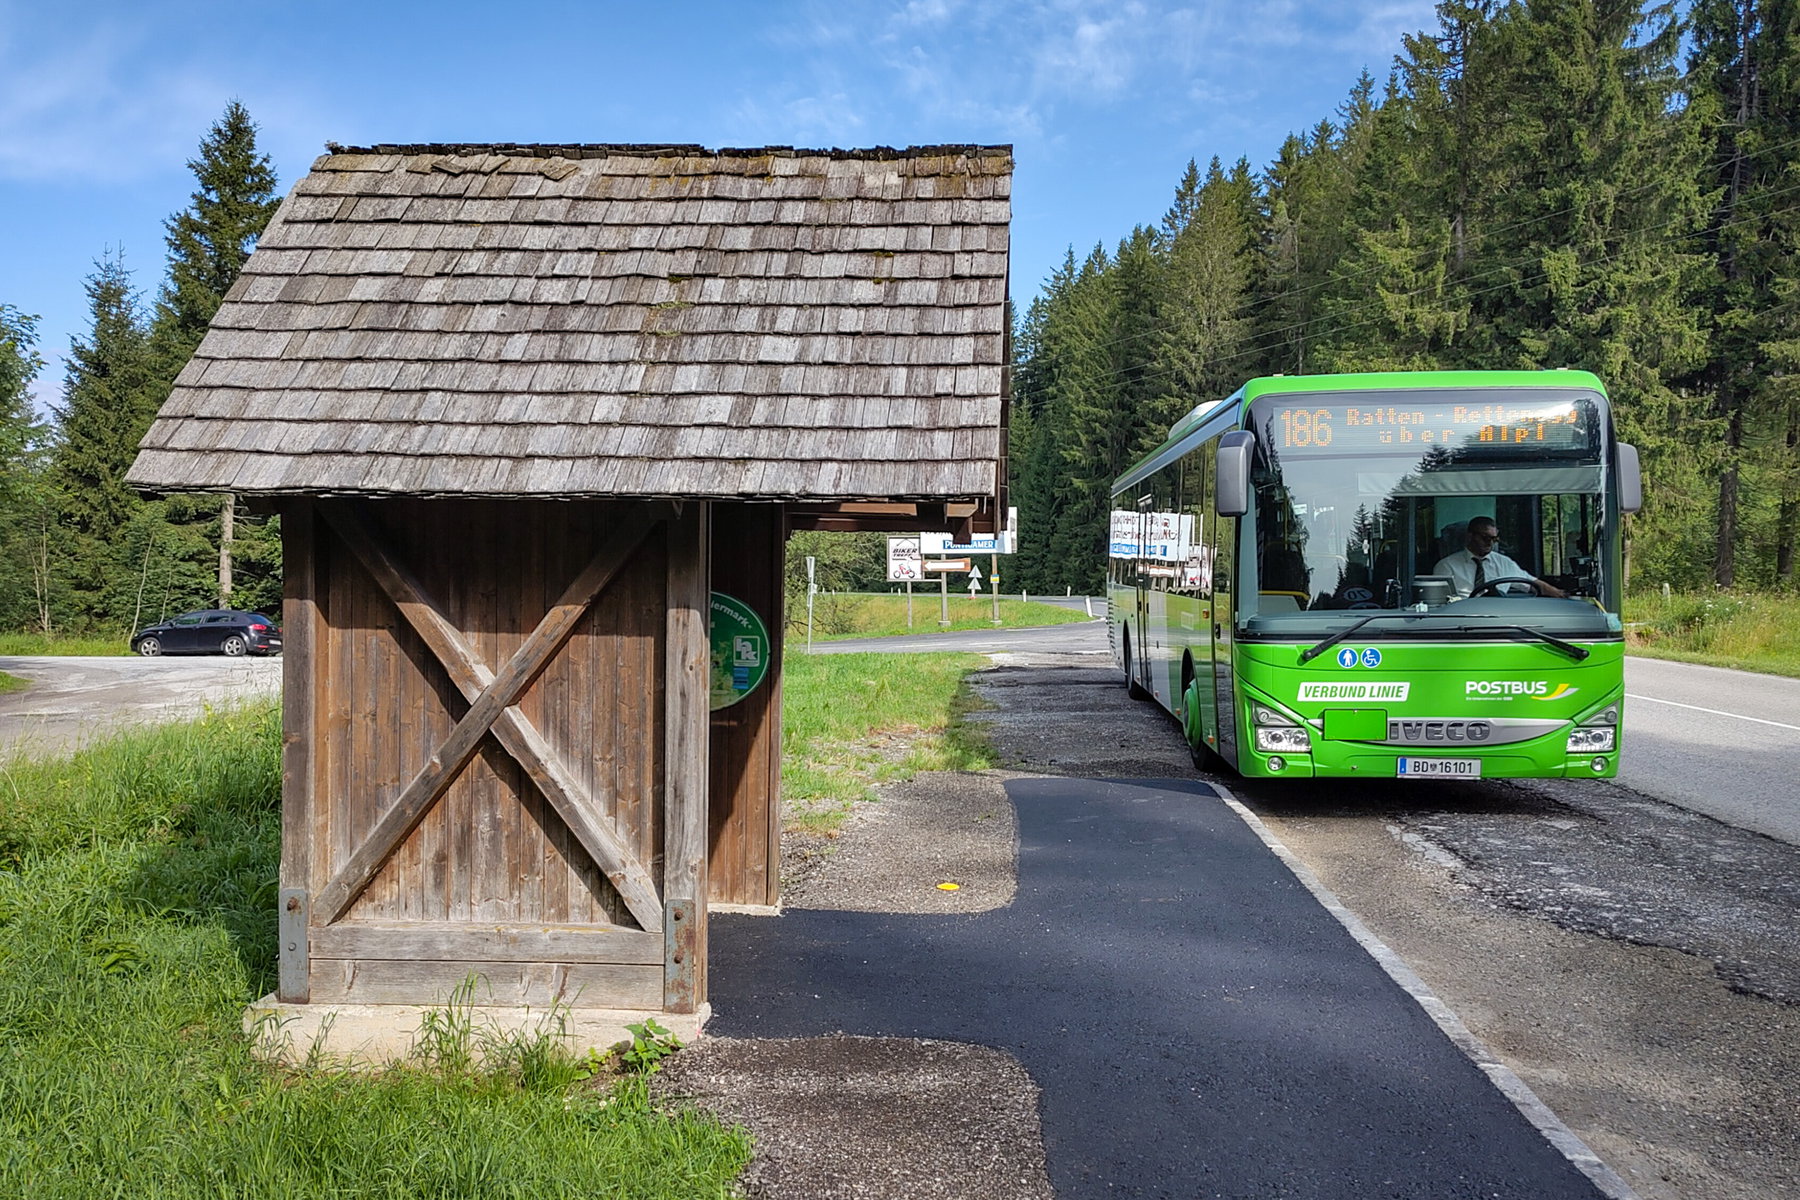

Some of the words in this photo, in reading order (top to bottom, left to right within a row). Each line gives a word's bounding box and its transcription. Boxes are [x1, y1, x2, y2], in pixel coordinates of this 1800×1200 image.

[1346, 407, 1425, 426] Ratten
[1453, 405, 1578, 424] Retteng
[1280, 409, 1333, 447] 186
[1379, 426, 1455, 443] über
[1479, 423, 1545, 443] Alpl
[1304, 685, 1366, 698] VERBUND
[1368, 685, 1404, 698] LINIE
[1465, 681, 1548, 695] POSTBUS
[1388, 720, 1491, 741] IVECO
[1413, 761, 1429, 773] BD
[1438, 762, 1473, 773] 16101
